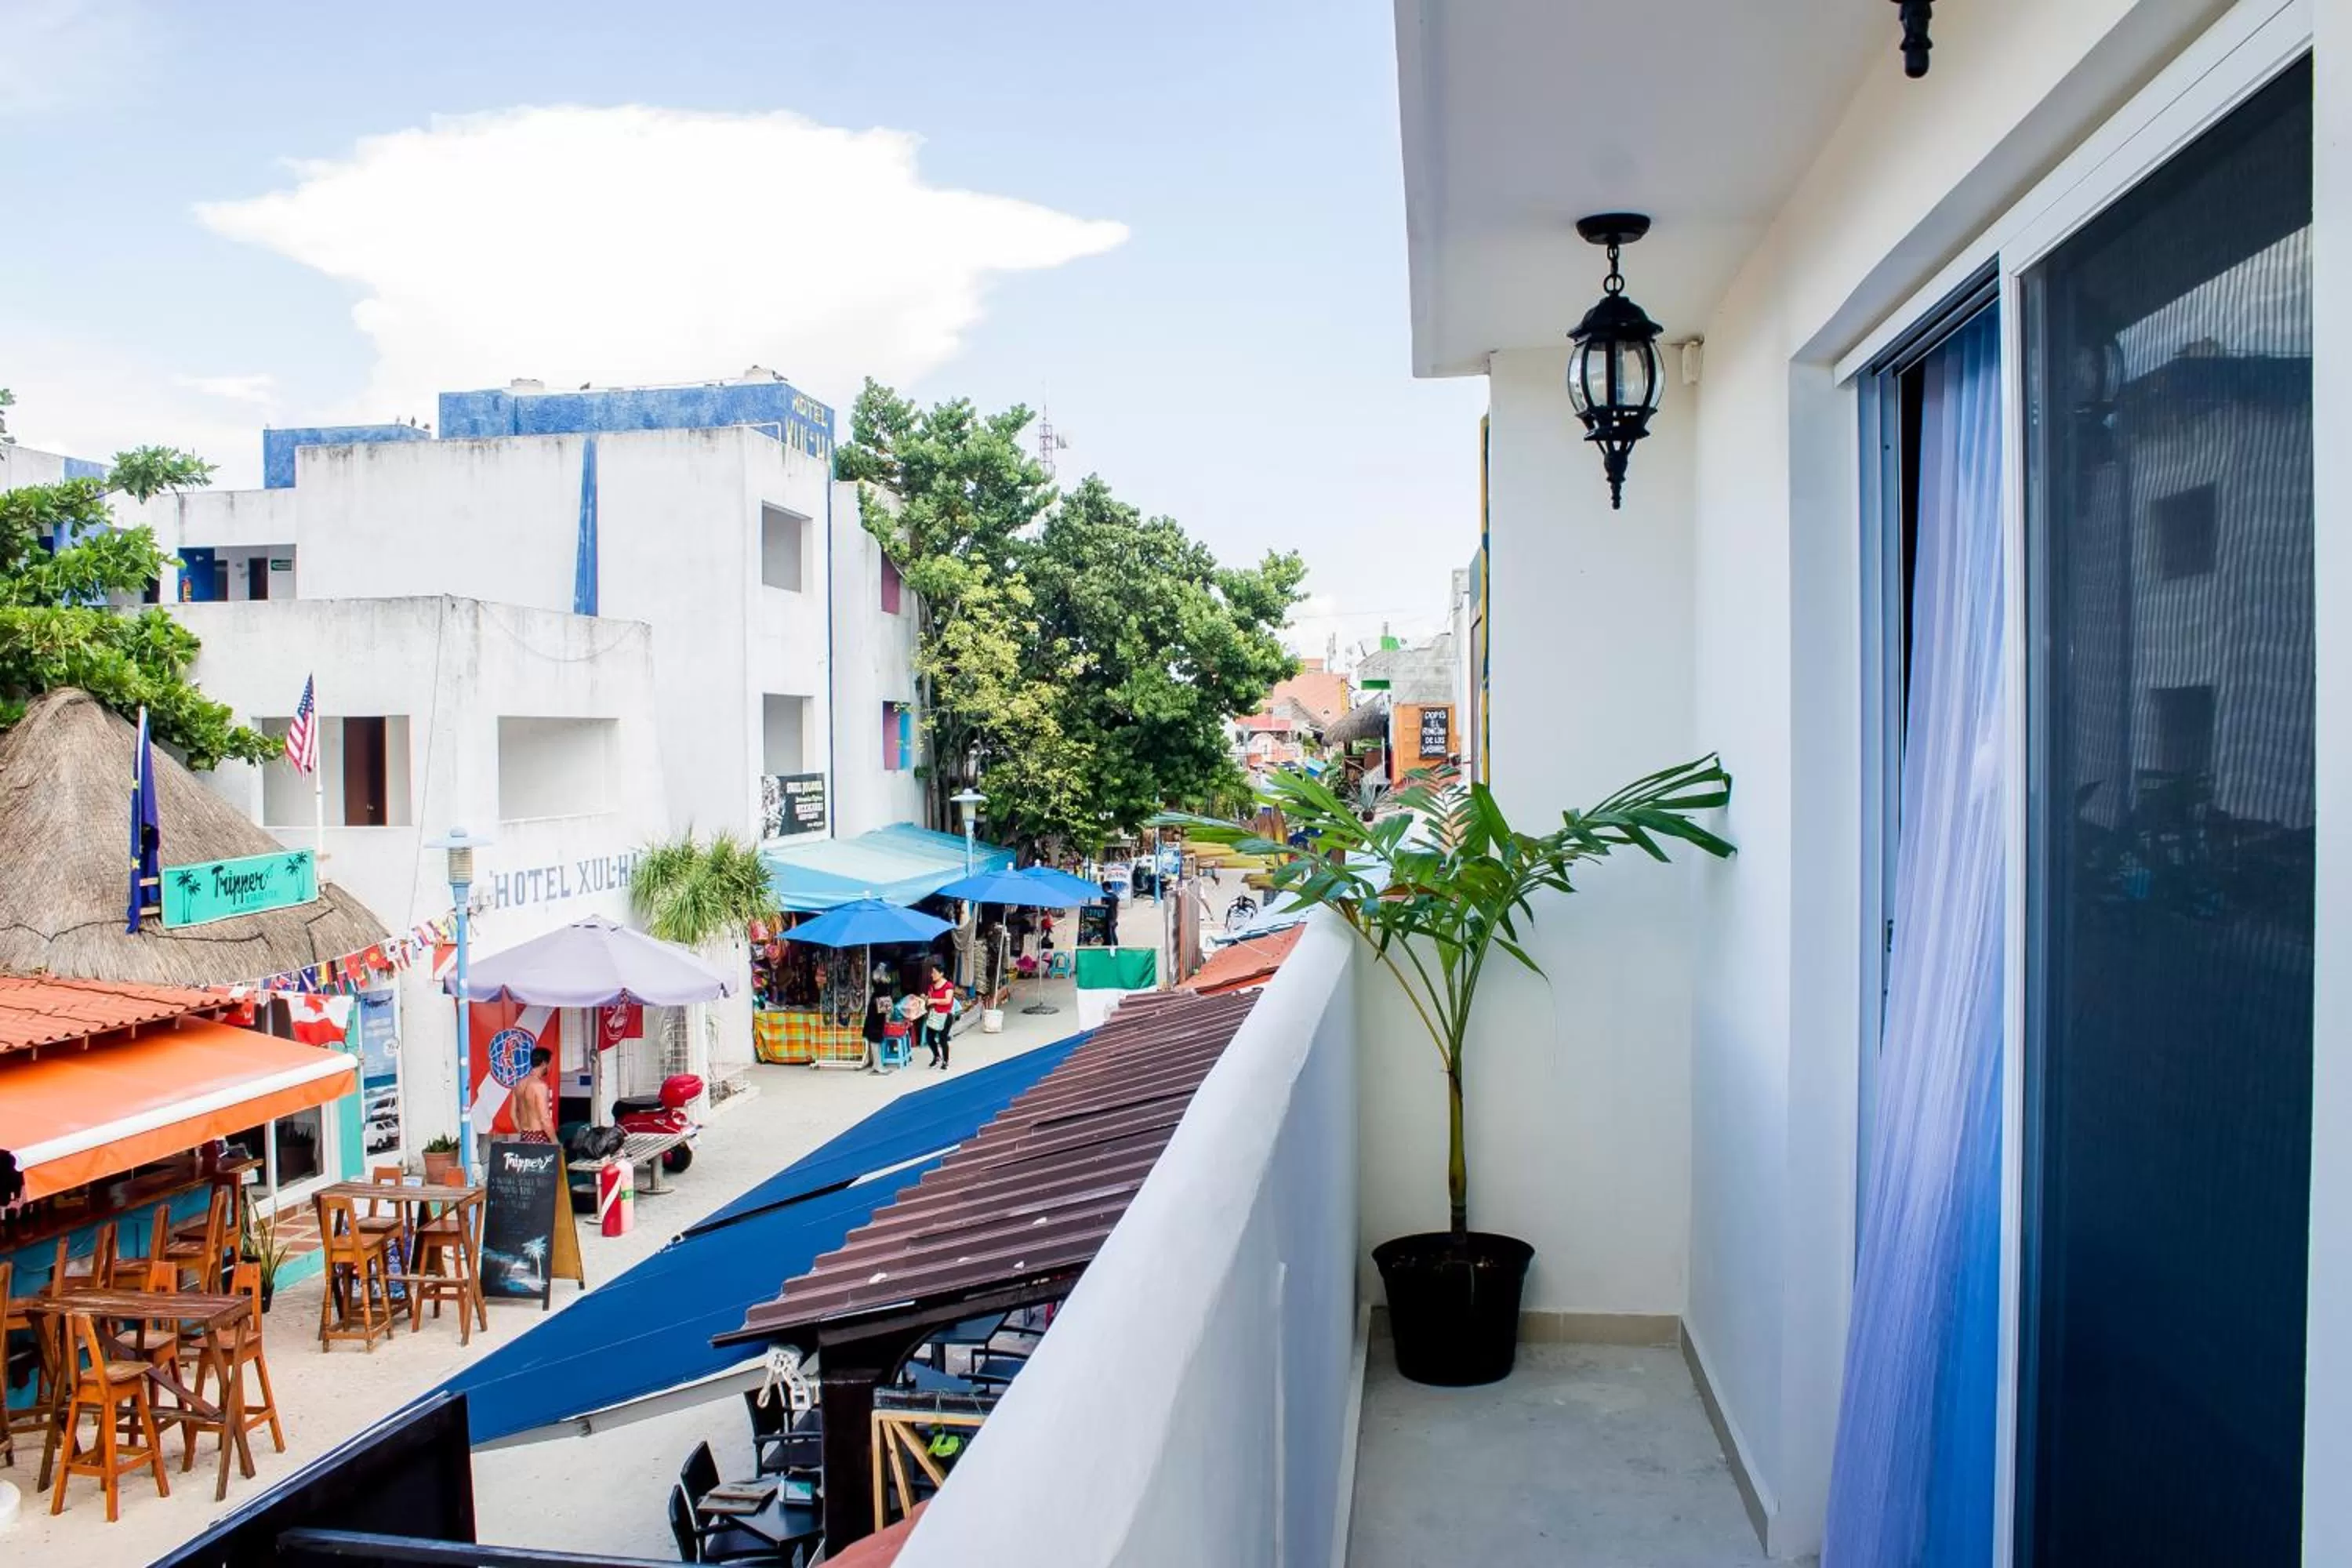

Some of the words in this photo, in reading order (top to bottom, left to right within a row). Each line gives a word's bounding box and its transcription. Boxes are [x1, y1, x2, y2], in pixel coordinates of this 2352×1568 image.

[793, 396, 828, 426] HOTEL
[211, 865, 267, 906] Tripper
[494, 865, 572, 909] HOTEL
